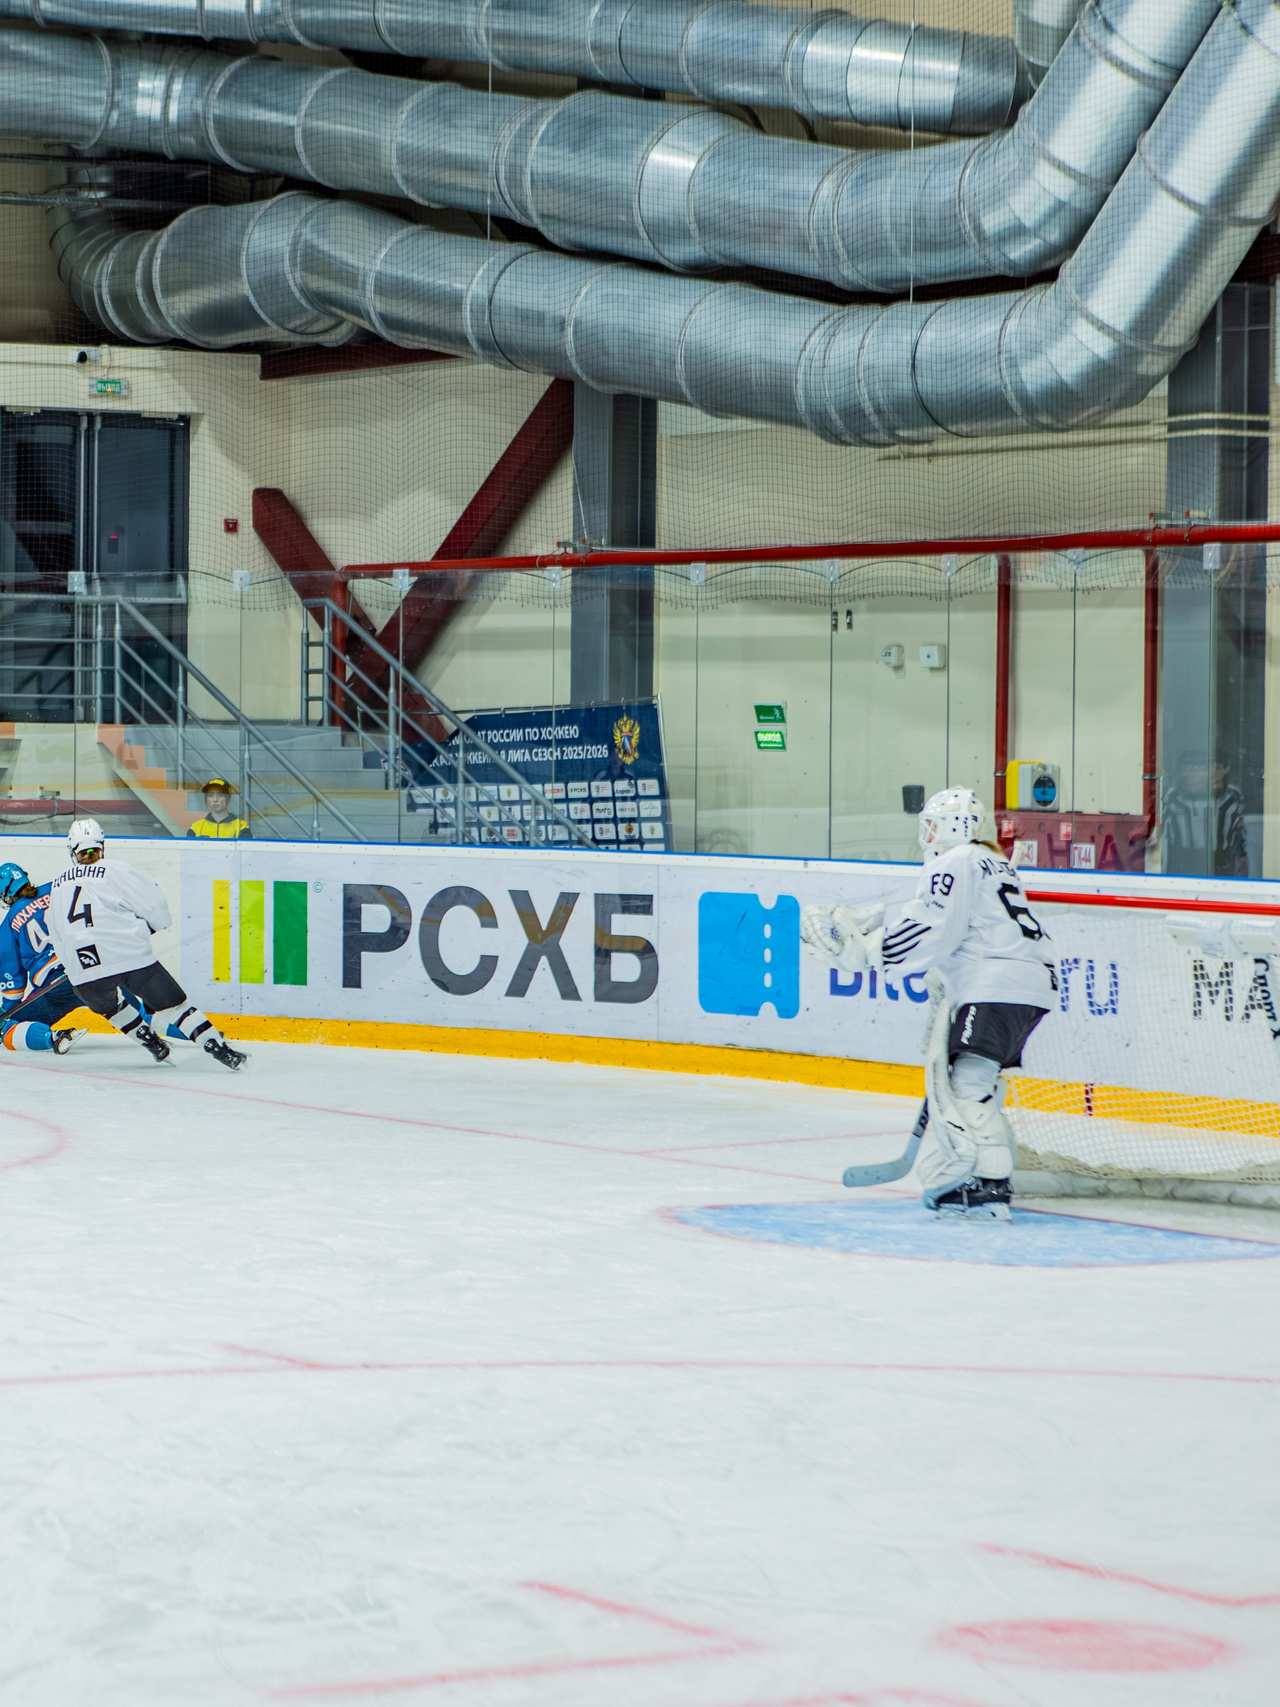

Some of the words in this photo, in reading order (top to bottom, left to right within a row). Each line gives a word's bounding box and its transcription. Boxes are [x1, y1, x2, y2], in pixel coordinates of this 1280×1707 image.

[488, 728, 524, 744] РОССИИ
[525, 727, 537, 741] ПО
[540, 725, 580, 741] ХОККЕЮ
[757, 733, 782, 743] ВЫХОД
[507, 748, 531, 763] ЛИГА
[562, 744, 609, 761] 2025/2026
[66, 885, 94, 928] 4
[342, 883, 660, 1005] РСХБ
